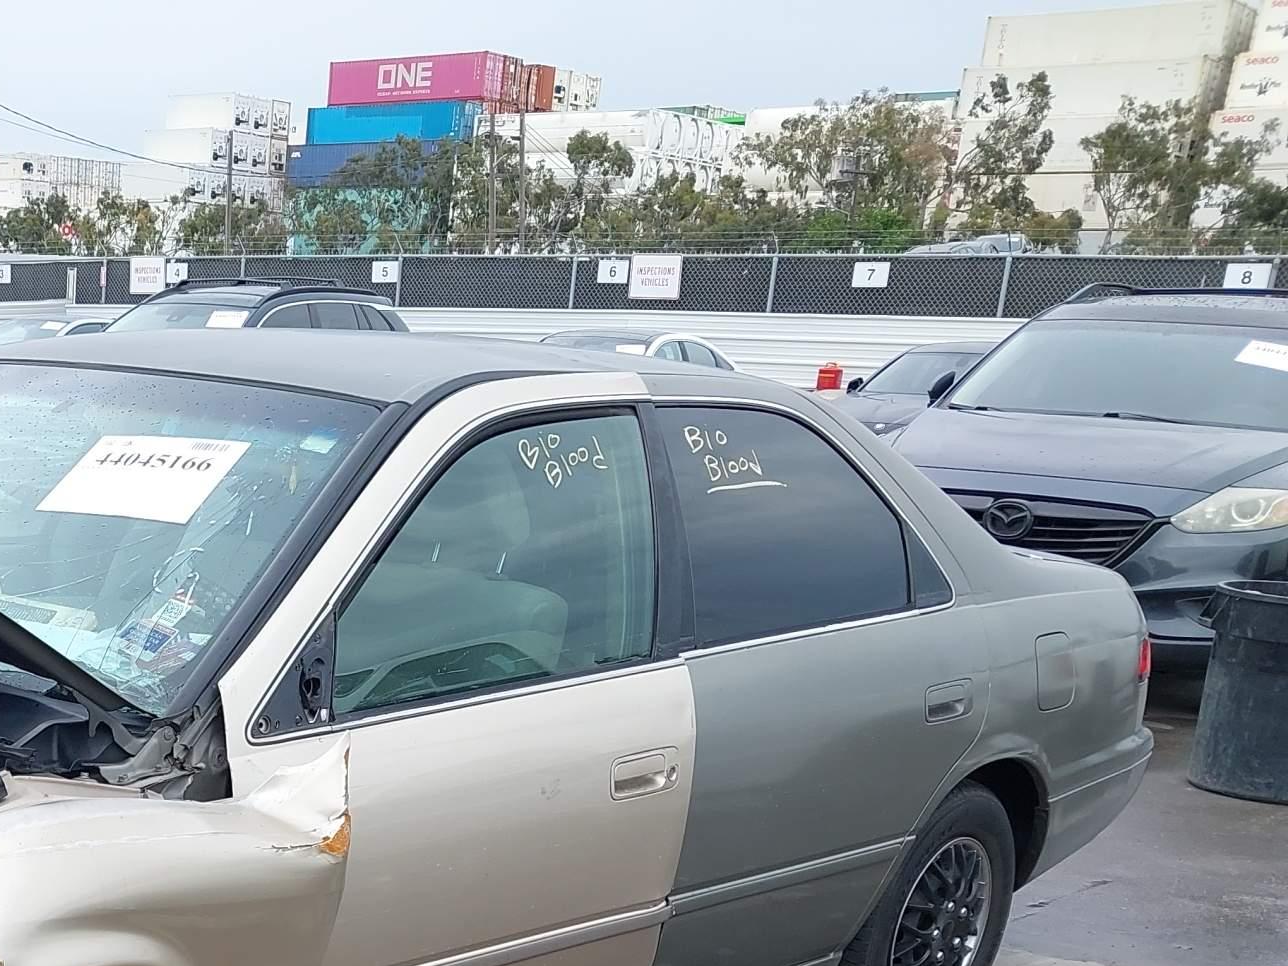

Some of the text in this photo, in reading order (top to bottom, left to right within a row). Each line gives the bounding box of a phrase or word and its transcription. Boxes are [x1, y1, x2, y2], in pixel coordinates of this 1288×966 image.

[1246, 56, 1280, 65] seaco
[377, 61, 433, 90] ONE
[1222, 114, 1255, 123] seaco
[173, 267, 181, 278] 4
[381, 266, 389, 278] 5
[609, 265, 617, 278] 6
[636, 266, 676, 276] INSPECTIONS
[867, 268, 876, 281] 7
[1241, 270, 1253, 285] 8
[640, 278, 669, 287] VEHICLES
[518, 431, 561, 470] Bio
[95, 452, 215, 472] 44045166
[544, 435, 609, 488] Blood
[703, 448, 763, 482] Blood
